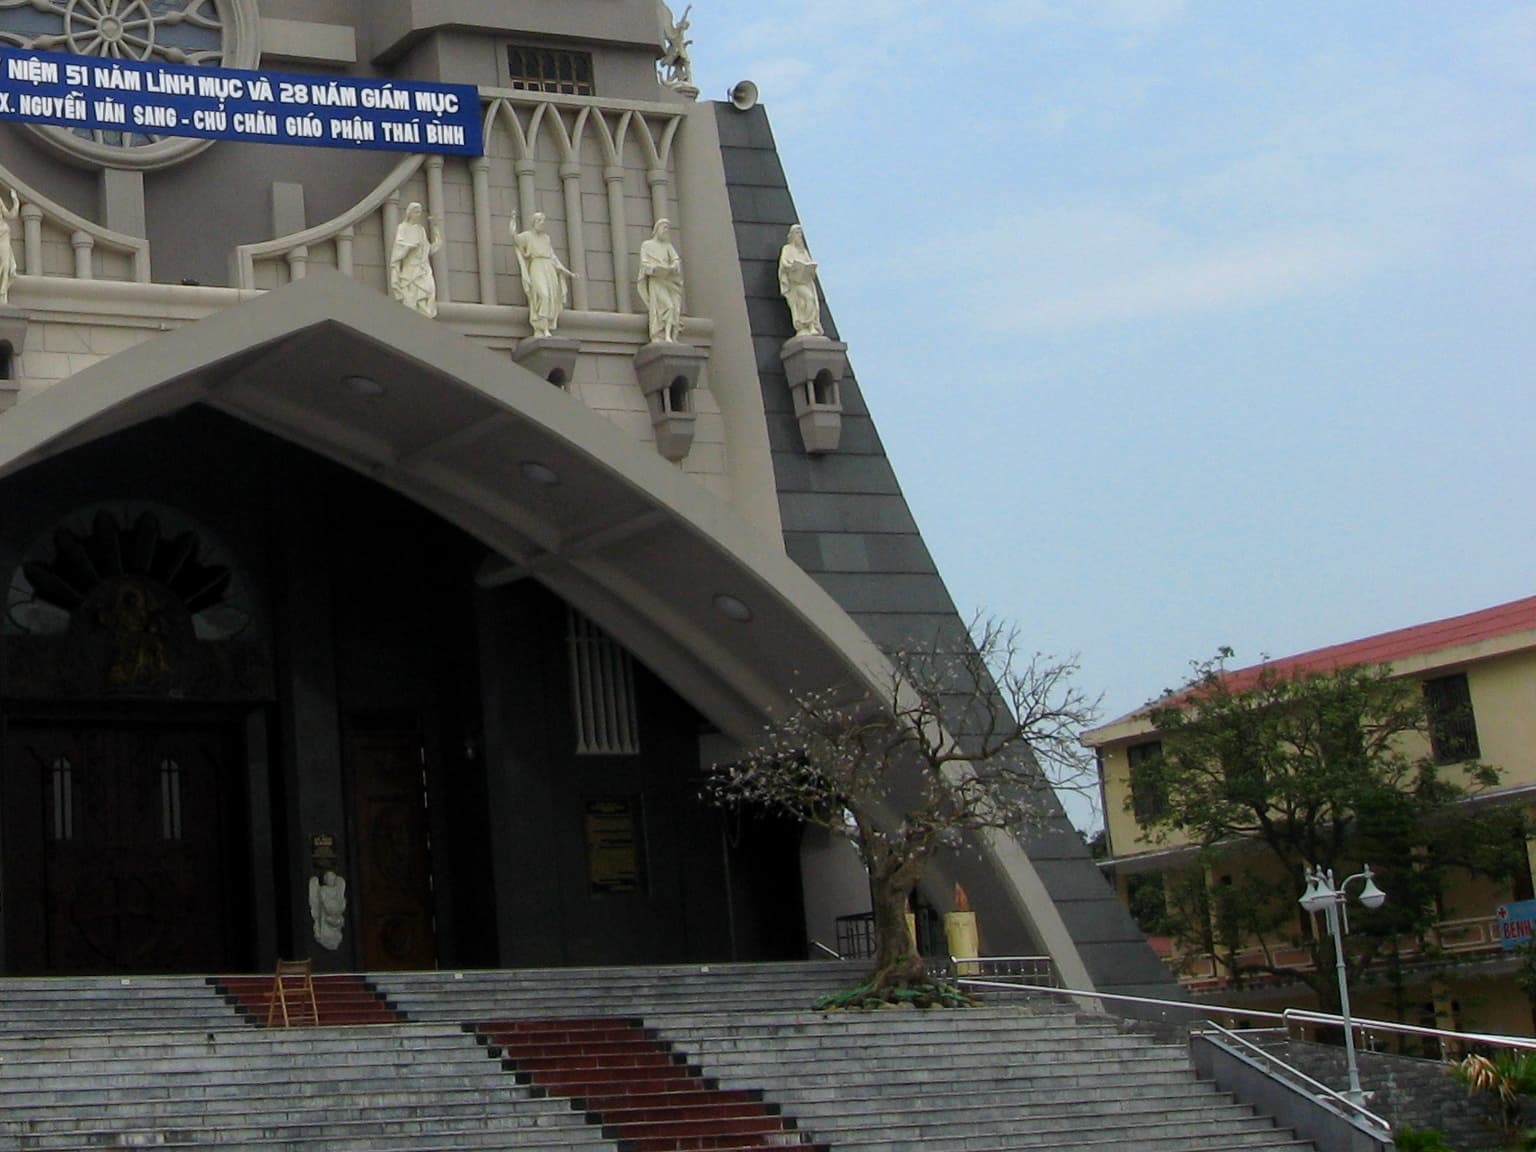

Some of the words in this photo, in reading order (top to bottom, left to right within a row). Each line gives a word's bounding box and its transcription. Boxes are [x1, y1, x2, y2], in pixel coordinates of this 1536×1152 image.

[8, 56, 59, 86] NIỆM
[66, 64, 88, 86] 51
[94, 64, 141, 92] NĂM
[198, 76, 243, 102] MỤC
[246, 76, 275, 102] VÀ
[279, 82, 309, 104] 28
[311, 81, 357, 107] NĂM
[361, 83, 410, 111] GIÁM
[414, 91, 459, 117] MỤC
[19, 90, 87, 121] NGUYỄN
[94, 96, 126, 124] VĂN
[133, 104, 177, 128] SANG
[194, 103, 227, 132] CHỦ
[233, 110, 278, 135] CHĂN
[285, 112, 323, 138] GIÁO
[330, 115, 375, 145] PHẬN
[426, 119, 465, 146] BÌNH
